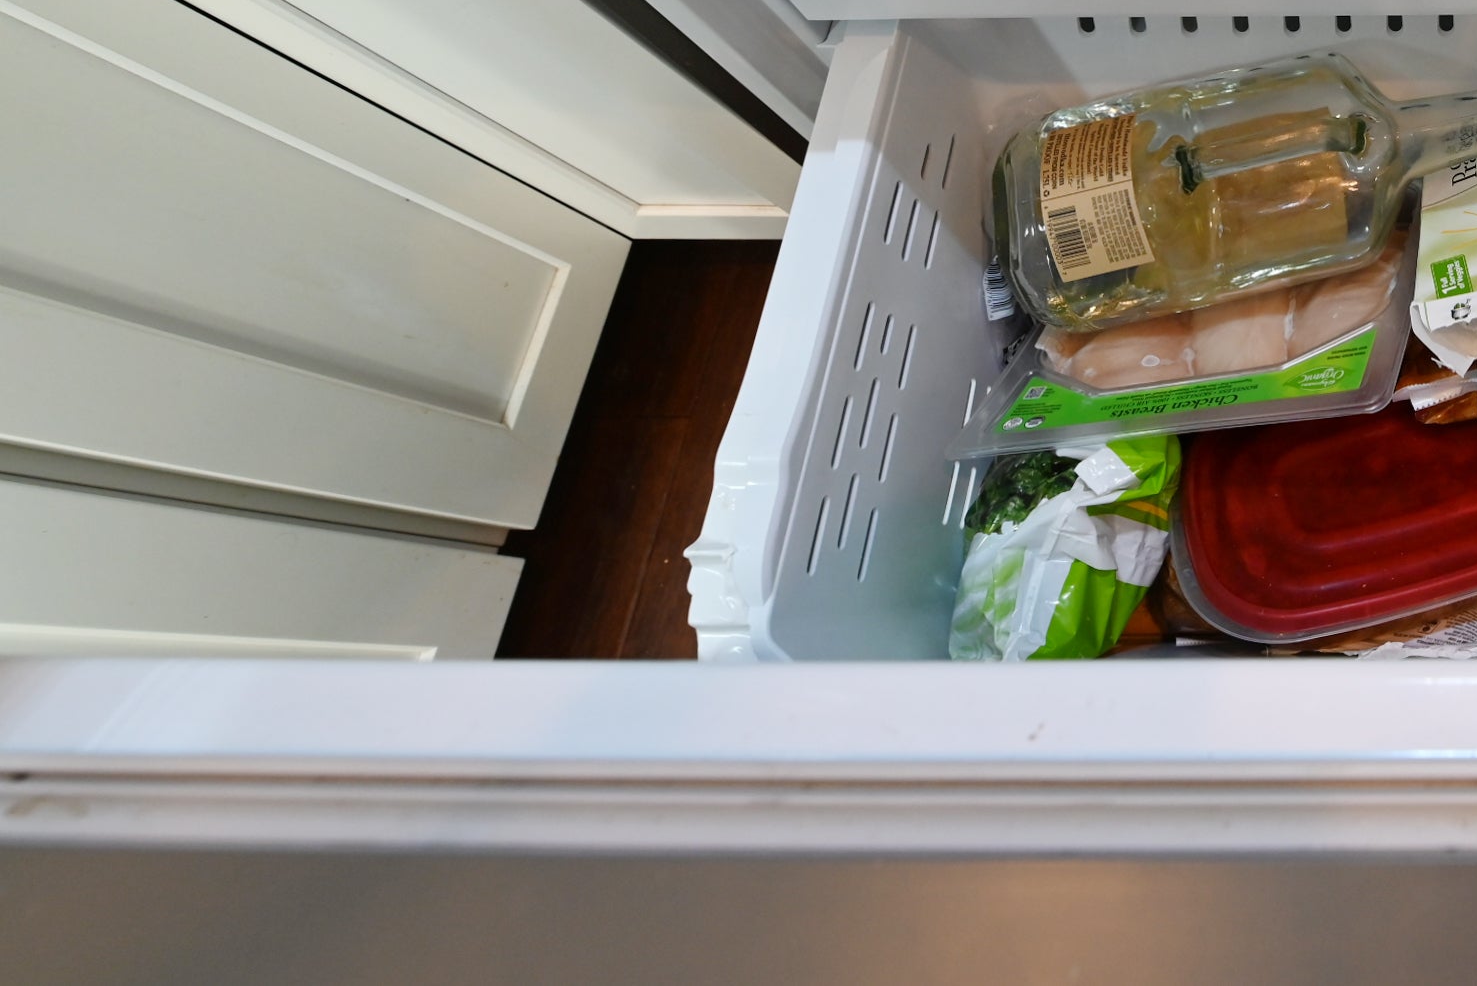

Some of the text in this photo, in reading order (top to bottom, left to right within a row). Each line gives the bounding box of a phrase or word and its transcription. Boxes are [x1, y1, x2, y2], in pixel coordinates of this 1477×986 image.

[1044, 142, 1055, 165] PROOF
[1052, 156, 1060, 172] FROM
[1447, 263, 1457, 287] Serving
[1453, 260, 1465, 283] Veggies
[1440, 277, 1458, 295] 1 Full
[1298, 368, 1344, 384] Organic
[1109, 394, 1238, 419] Chicken Breasts
